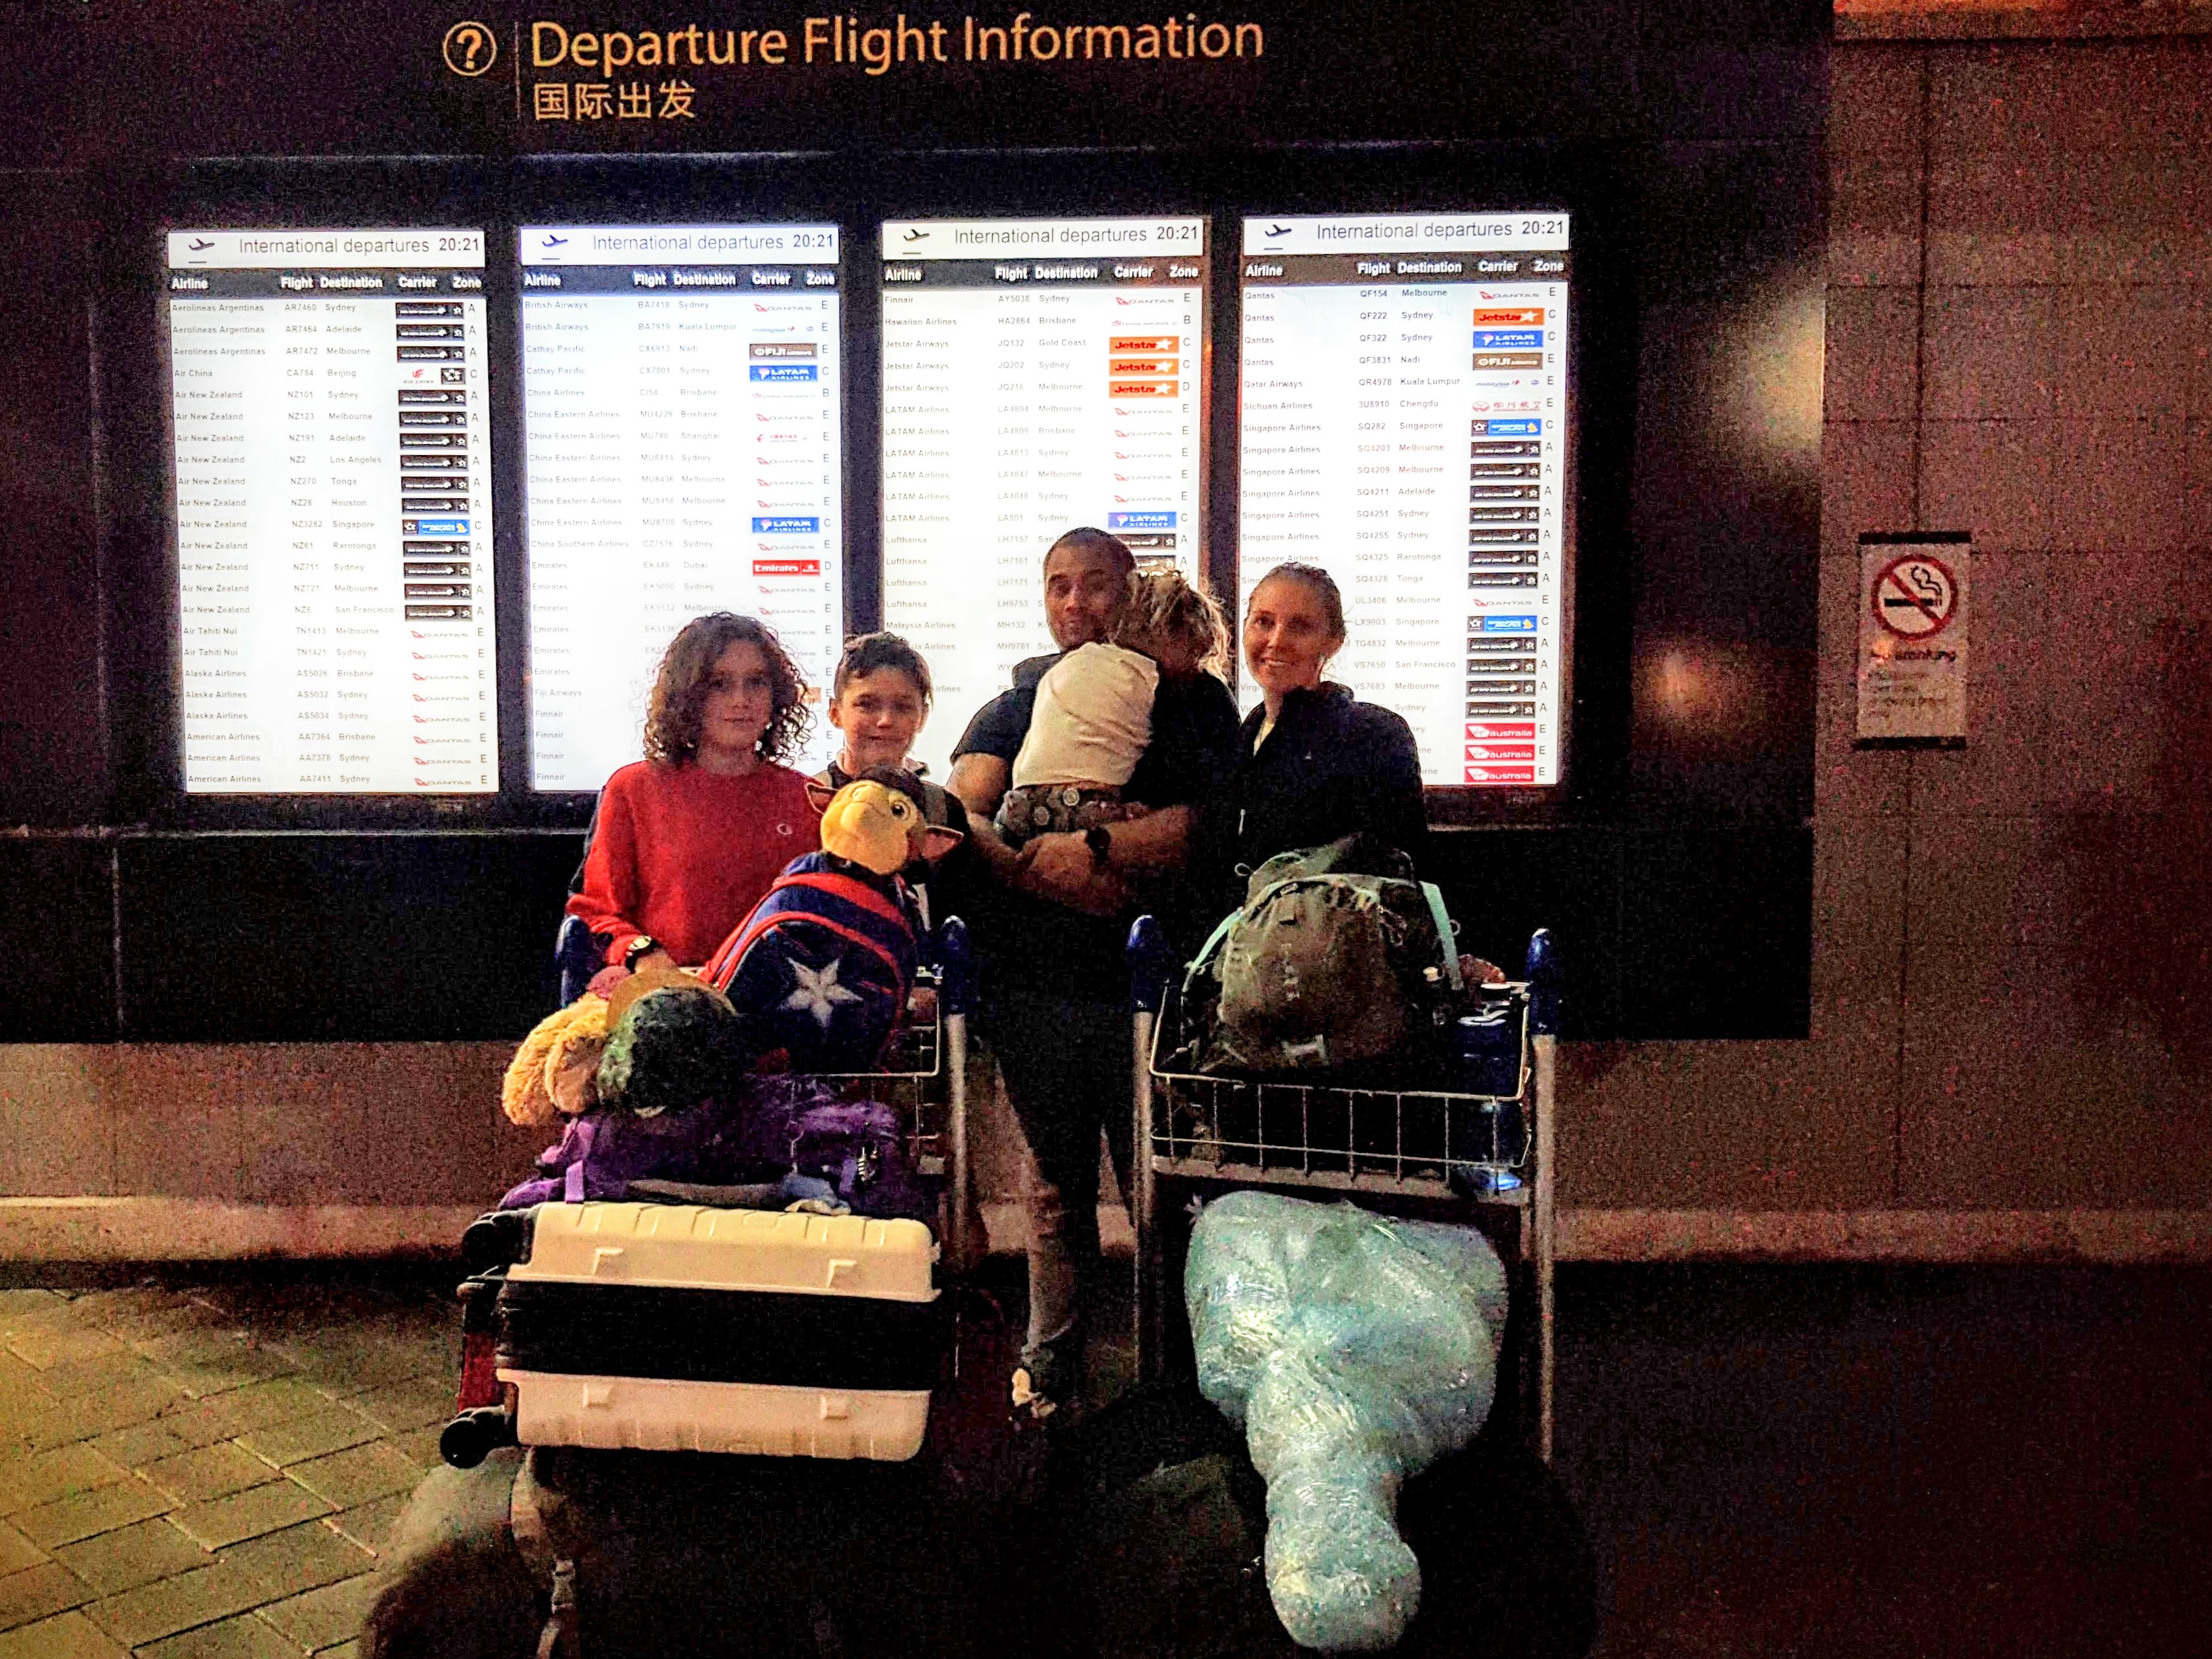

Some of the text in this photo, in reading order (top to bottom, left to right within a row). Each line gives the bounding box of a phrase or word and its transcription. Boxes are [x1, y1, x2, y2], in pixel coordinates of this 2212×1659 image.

[531, 12, 1265, 76] Departure Flight Information
[533, 79, 697, 120] 国际出发
[955, 225, 1197, 246] International departures 20:21
[1317, 220, 1563, 241] International departures 20:21
[240, 237, 479, 256] International departures 20:21
[593, 233, 833, 253] International departures 20:21
[885, 266, 1199, 280] Airline Flight Destination Carrier Zone
[1245, 261, 1564, 276] Airline Flight Destination Carrier Zone
[172, 277, 482, 290] Airline Flight Destination Carrier Zone
[524, 274, 835, 286] Airline Flight Destination Carrier Zone
[1549, 286, 1556, 297] E
[1183, 292, 1191, 303] E
[468, 303, 476, 313] A
[821, 300, 828, 310] E
[1183, 314, 1191, 324] B
[1479, 313, 1522, 322] Jetstar
[1548, 309, 1556, 319] C
[1547, 330, 1556, 341] C
[1182, 336, 1191, 347] C
[469, 347, 477, 356] A
[1547, 353, 1555, 364] E
[469, 368, 478, 379] C
[821, 366, 829, 376] C
[1547, 375, 1554, 386] E
[471, 413, 479, 422] A
[1545, 419, 1554, 430] C
[289, 455, 306, 464] NZ2
[472, 456, 481, 466] A
[474, 520, 482, 530] C
[1542, 551, 1551, 561] A
[755, 563, 798, 573] Emirates
[1540, 659, 1548, 669] A
[478, 669, 485, 680] E
[1538, 745, 1546, 755] E
[480, 753, 487, 764] E
